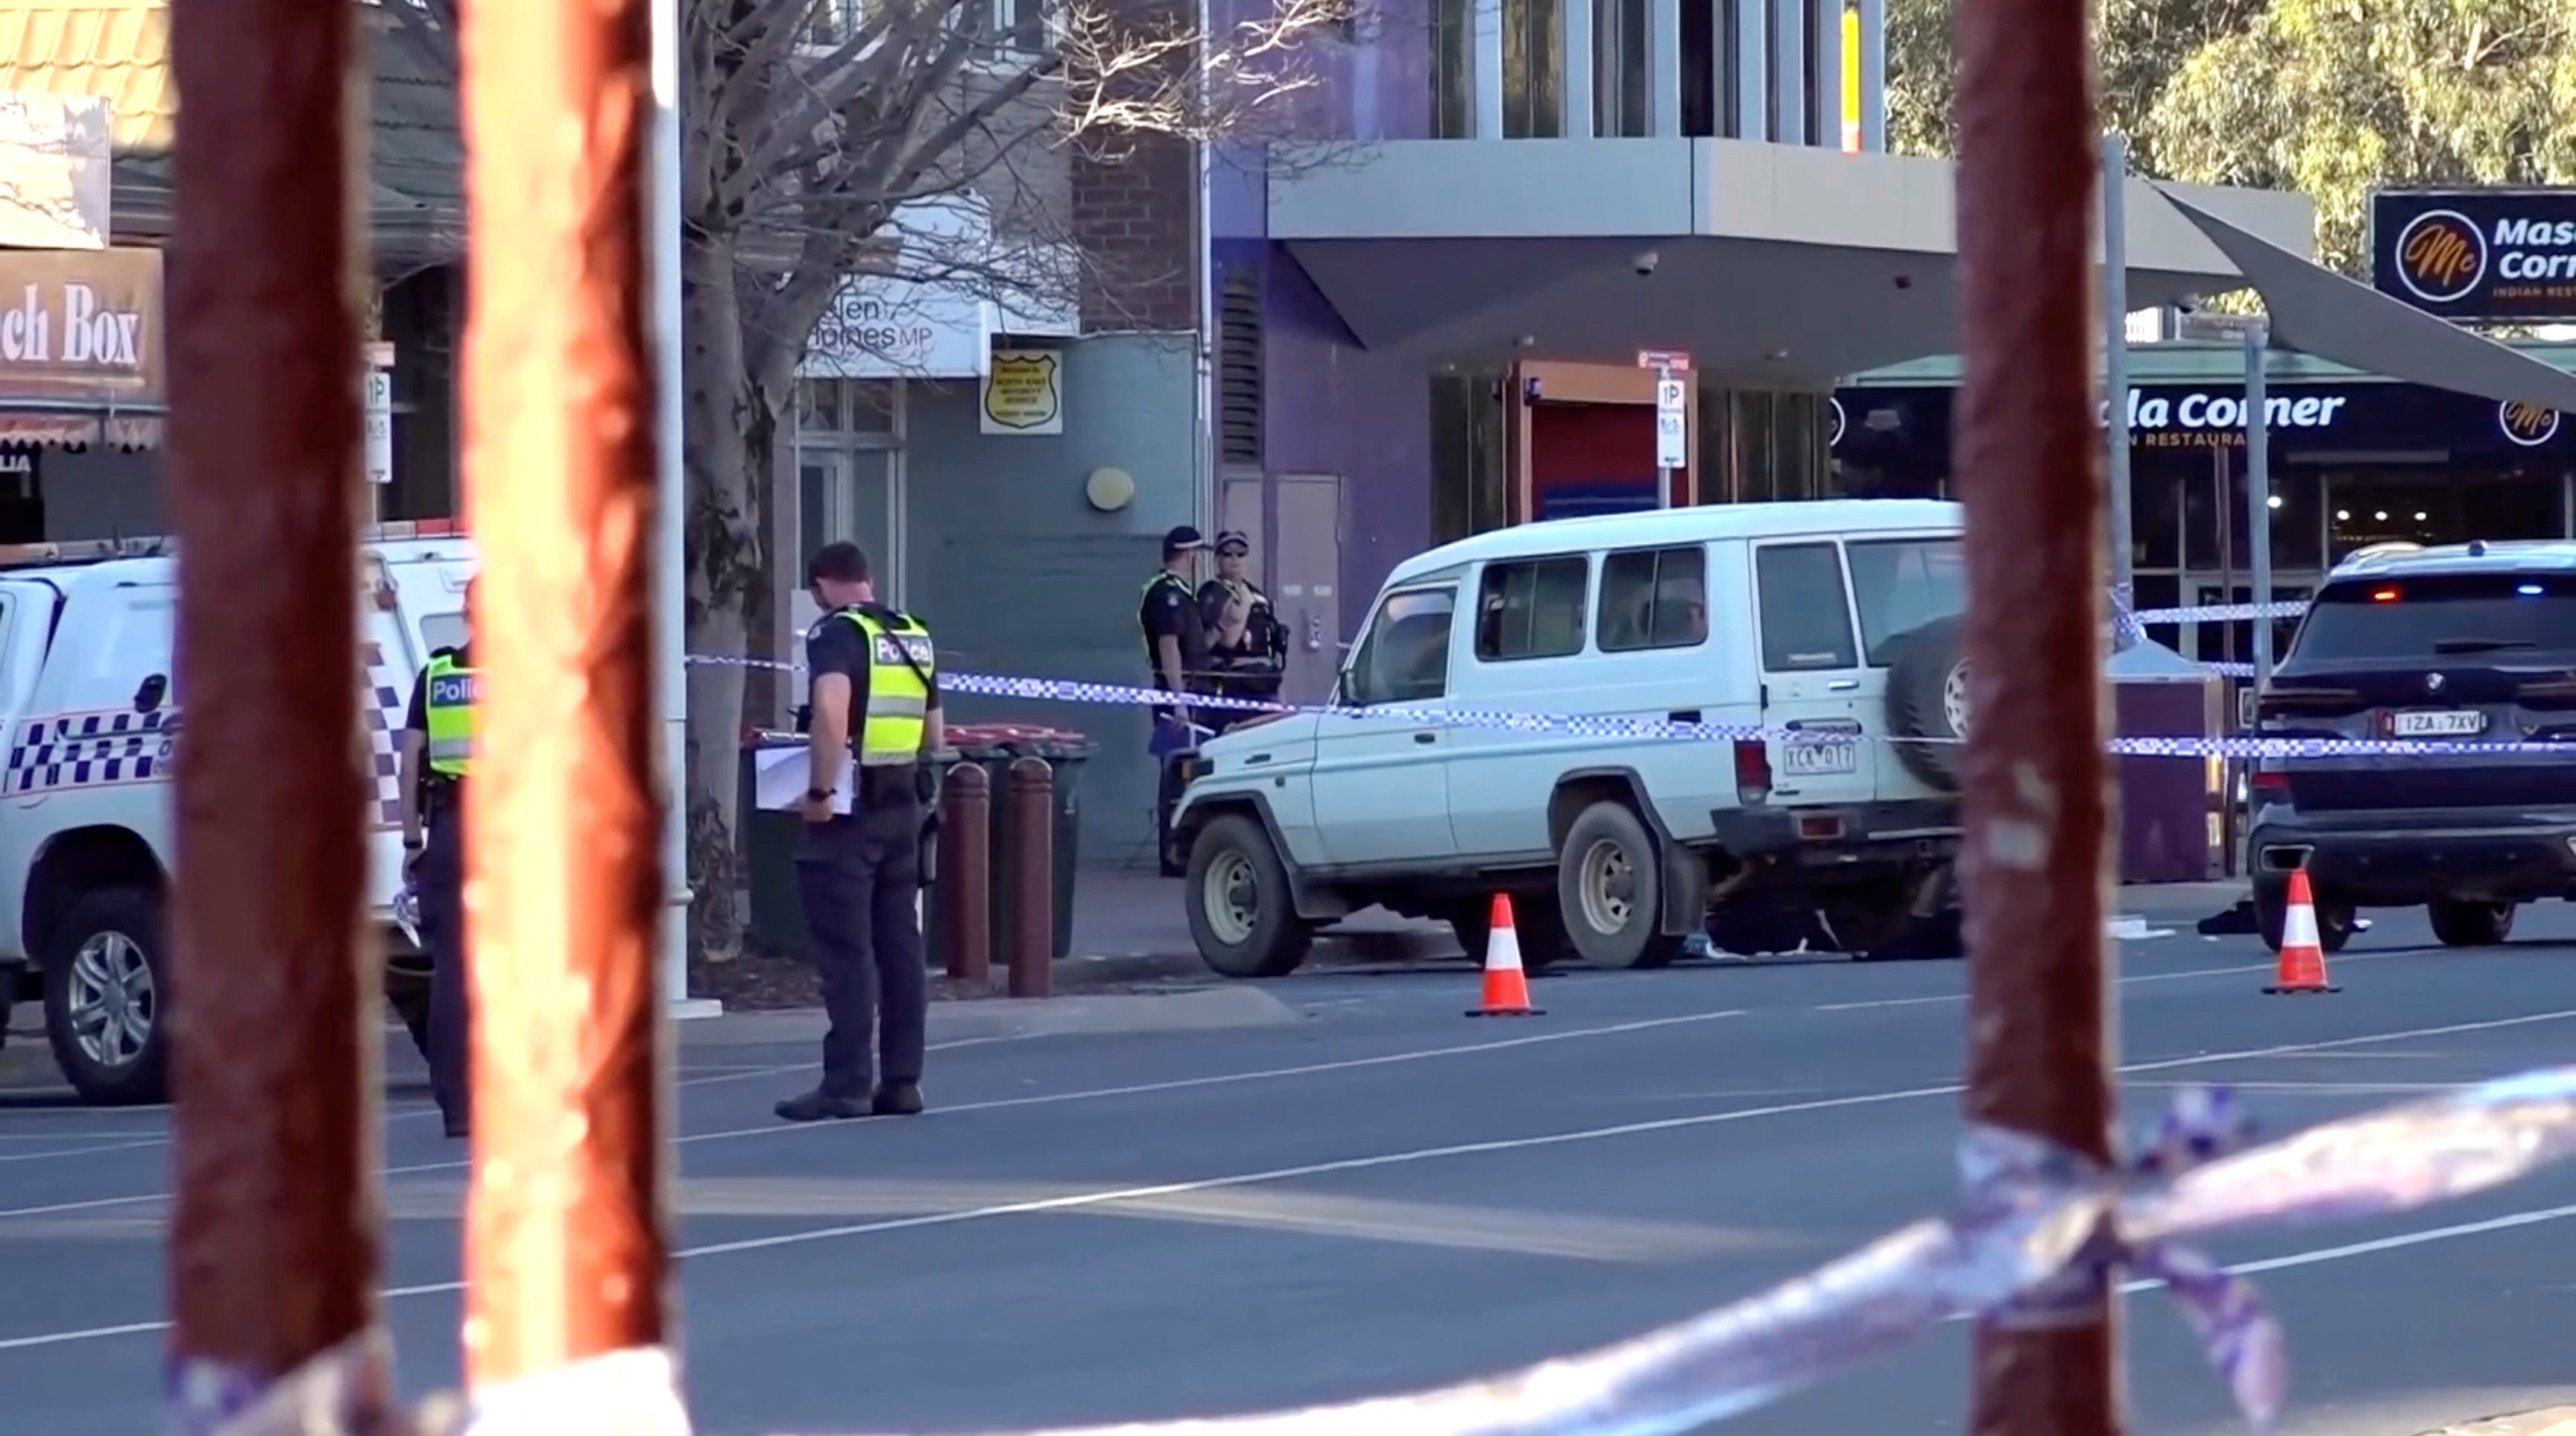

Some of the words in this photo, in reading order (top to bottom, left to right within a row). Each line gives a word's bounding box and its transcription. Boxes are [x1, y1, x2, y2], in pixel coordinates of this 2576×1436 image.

[2493, 218, 2576, 246] Mas
[61, 284, 139, 365] Box
[900, 328, 932, 347] MP
[2145, 432, 2271, 446] RESTAURA
[877, 638, 929, 661] Poice
[433, 677, 484, 700] Polic
